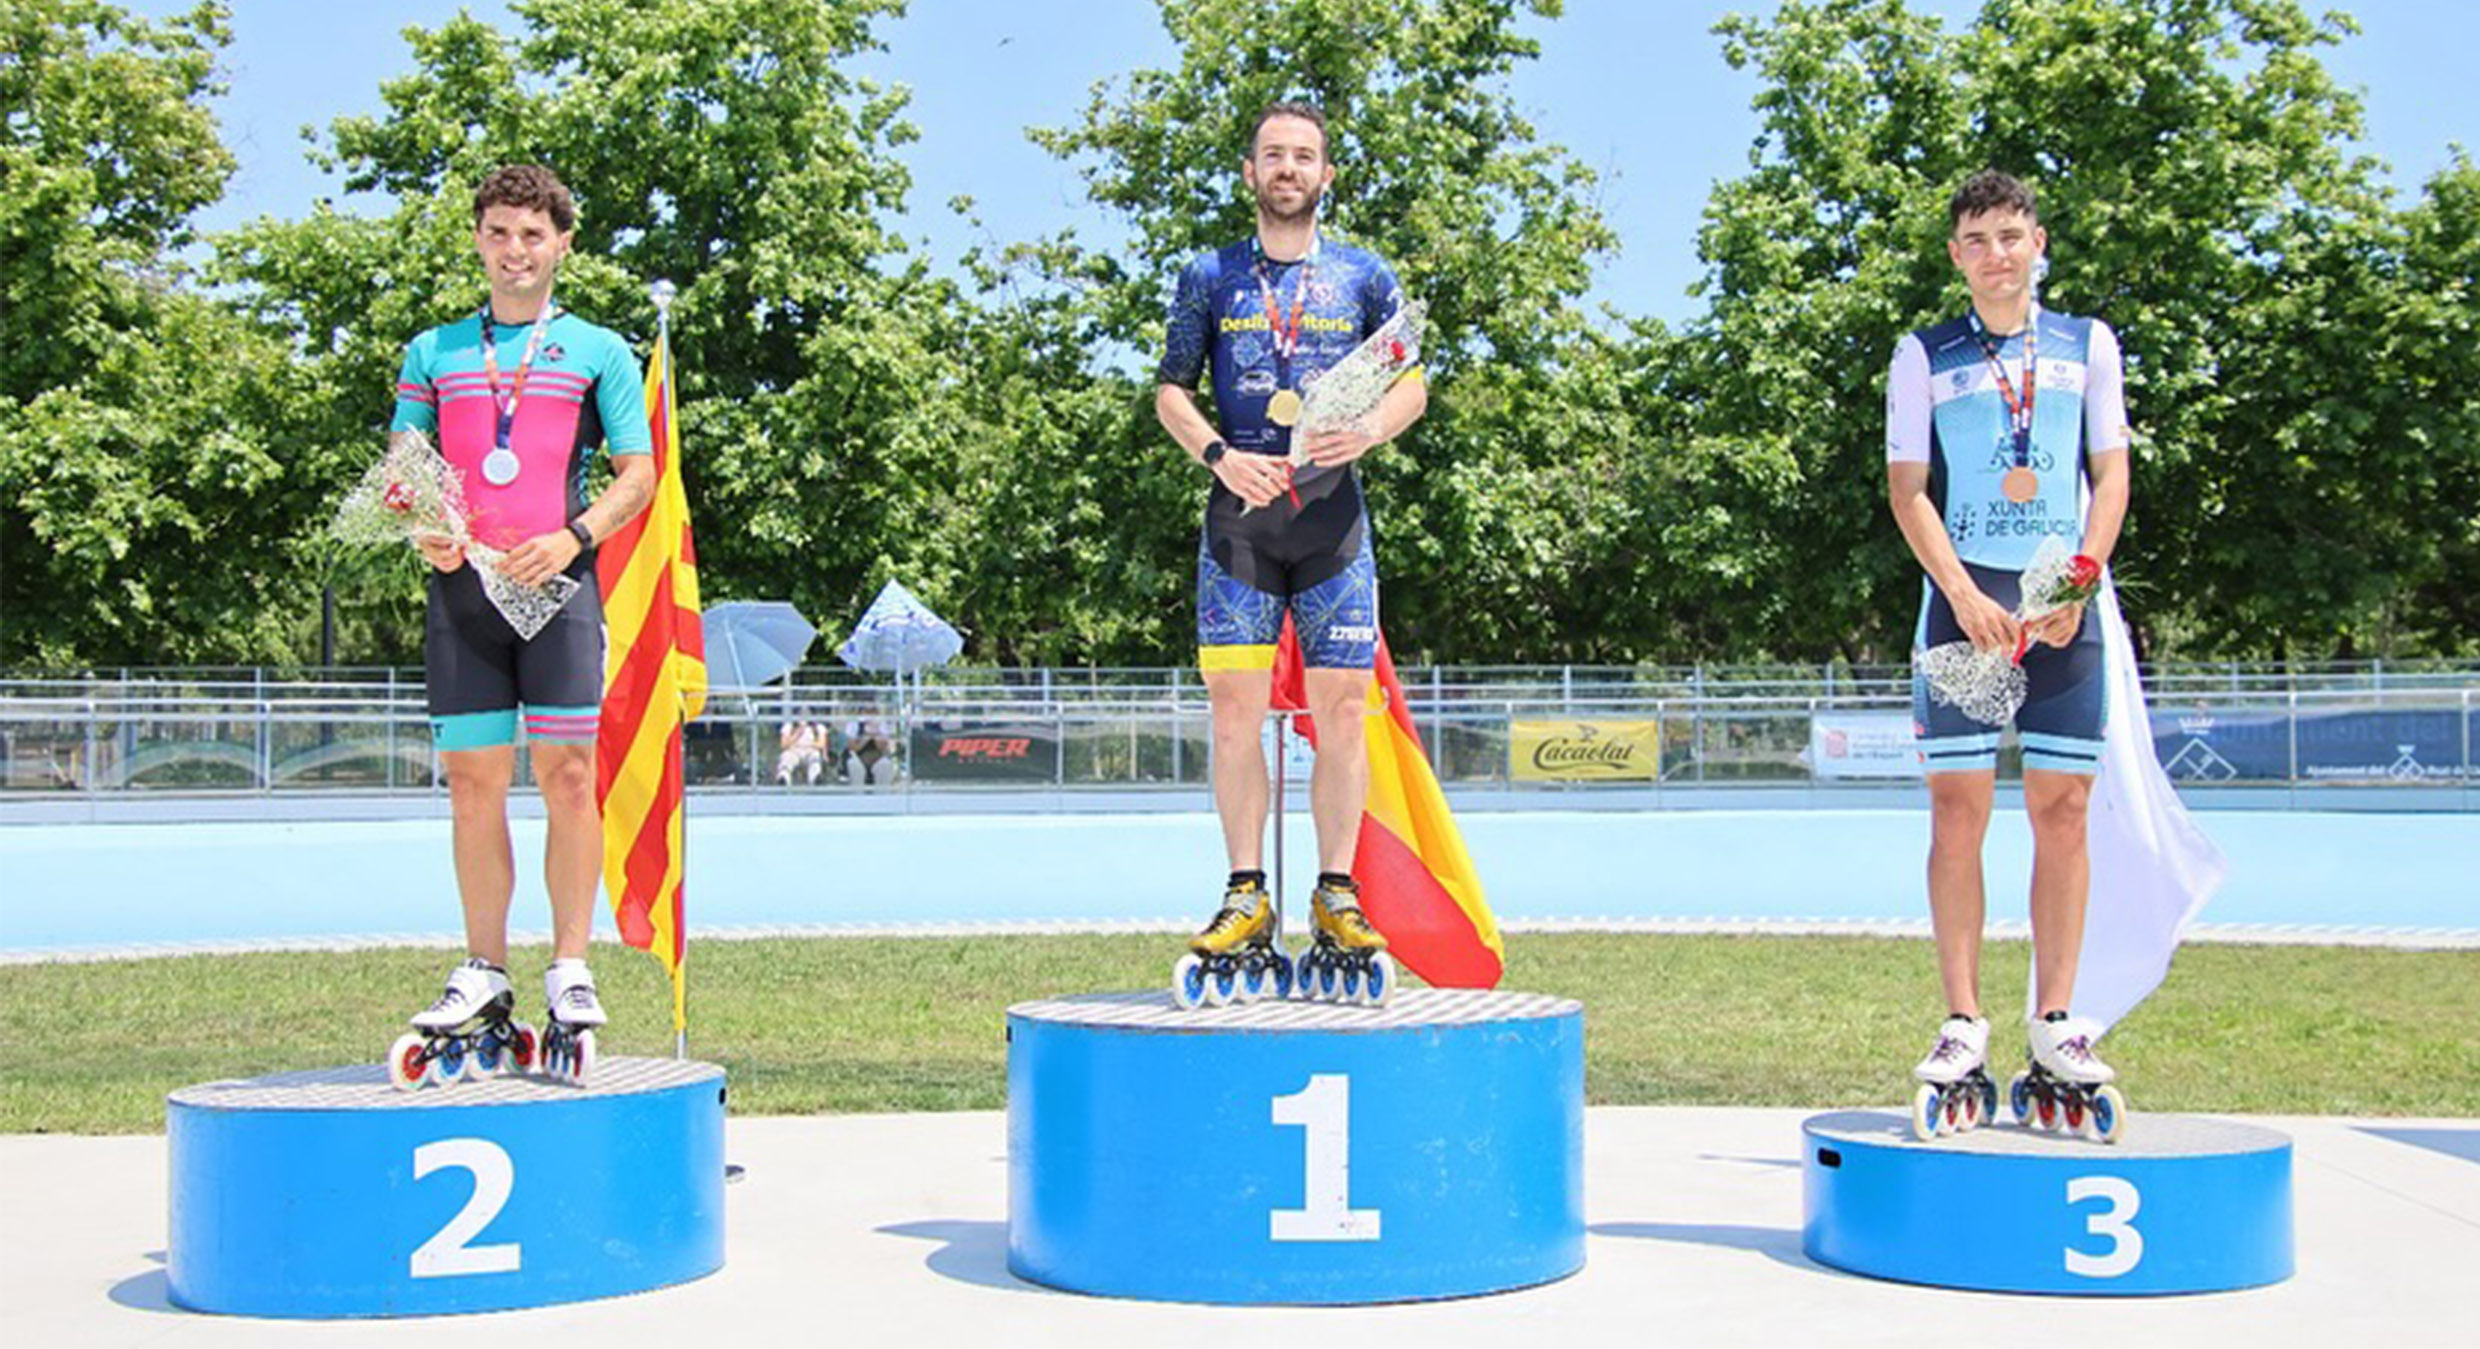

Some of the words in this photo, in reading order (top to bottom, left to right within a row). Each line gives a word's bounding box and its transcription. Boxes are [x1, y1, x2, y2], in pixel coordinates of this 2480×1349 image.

[1987, 500, 2048, 517] XUNTA
[938, 738, 1032, 758] PIPER
[1532, 737, 1635, 771] Cacaolat
[1270, 1073, 1381, 1240] 1
[410, 1137, 521, 1279] 2
[2064, 1176, 2144, 1278] 3
